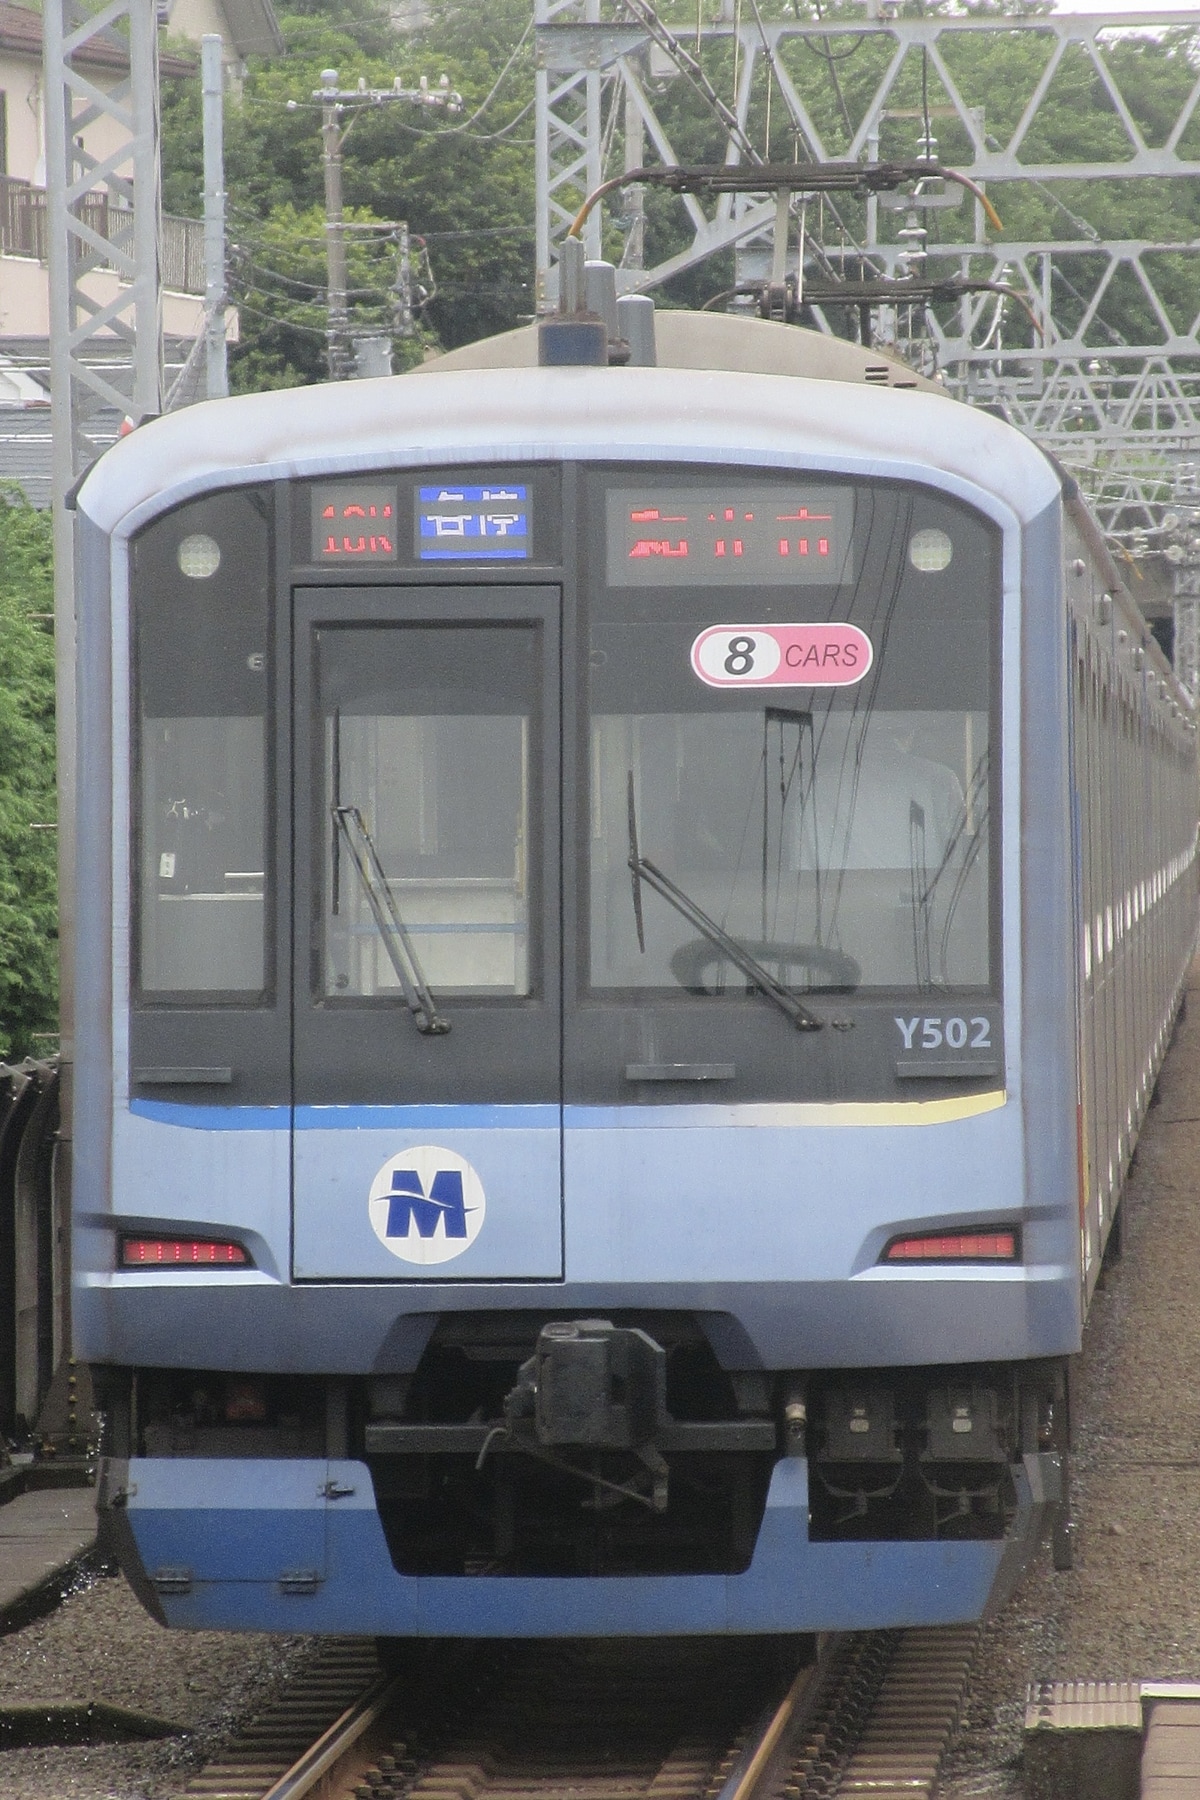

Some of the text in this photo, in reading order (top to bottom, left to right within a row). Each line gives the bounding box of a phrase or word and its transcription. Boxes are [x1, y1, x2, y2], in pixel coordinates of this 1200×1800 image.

[724, 636, 859, 676] 8 CARS
[894, 1016, 991, 1049] Y502
